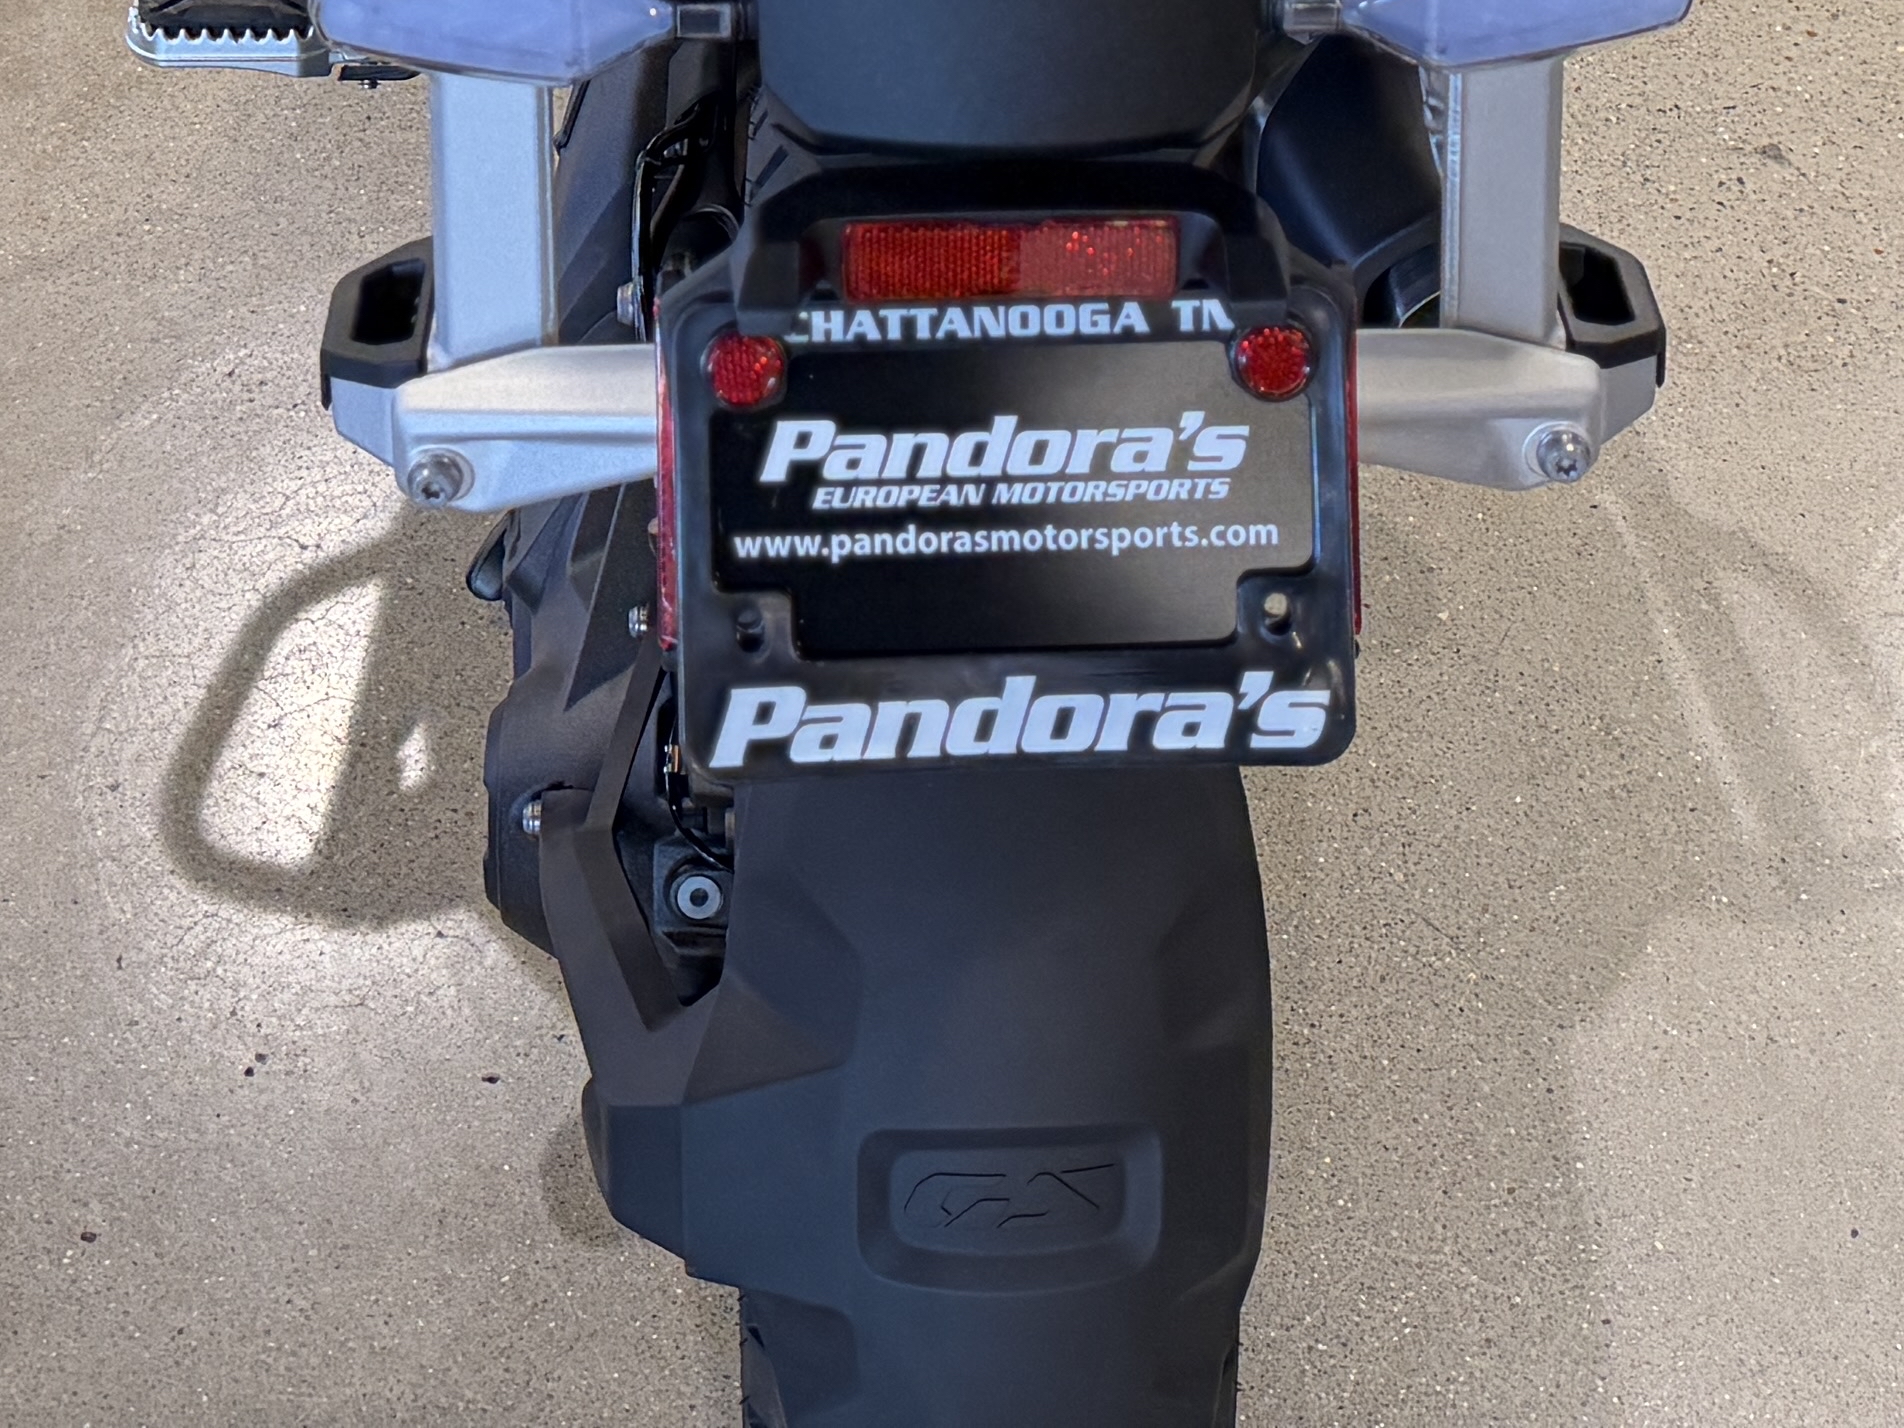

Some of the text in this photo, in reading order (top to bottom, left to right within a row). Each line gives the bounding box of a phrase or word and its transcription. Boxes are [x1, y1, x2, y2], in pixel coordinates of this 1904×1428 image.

[759, 410, 1250, 482] Pandora's
[812, 477, 1230, 511] EUROPEAN MOTORSPORTS
[733, 520, 1280, 562] www.pandorasmotorsports.com
[710, 672, 1332, 769] Pandora's
